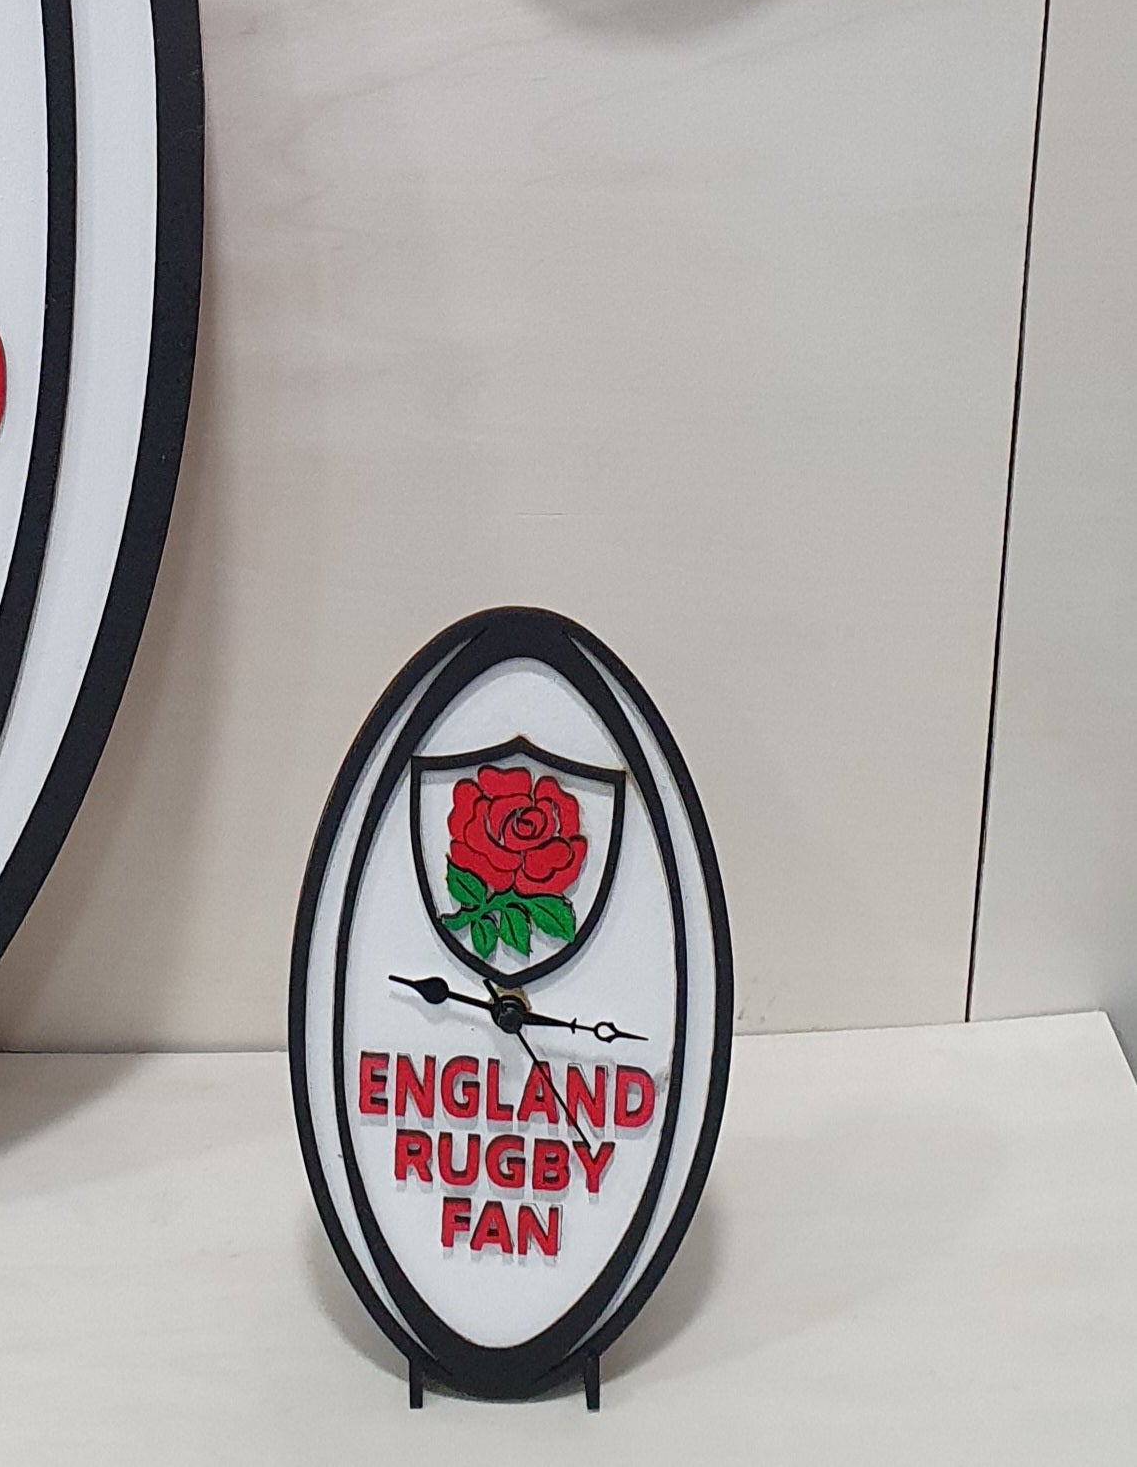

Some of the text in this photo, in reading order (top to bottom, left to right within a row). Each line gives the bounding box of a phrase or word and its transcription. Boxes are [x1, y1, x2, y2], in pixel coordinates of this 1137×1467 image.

[358, 1051, 656, 1129] ENGLAND
[393, 1130, 615, 1195] RUGBY
[440, 1197, 560, 1256] FAN
